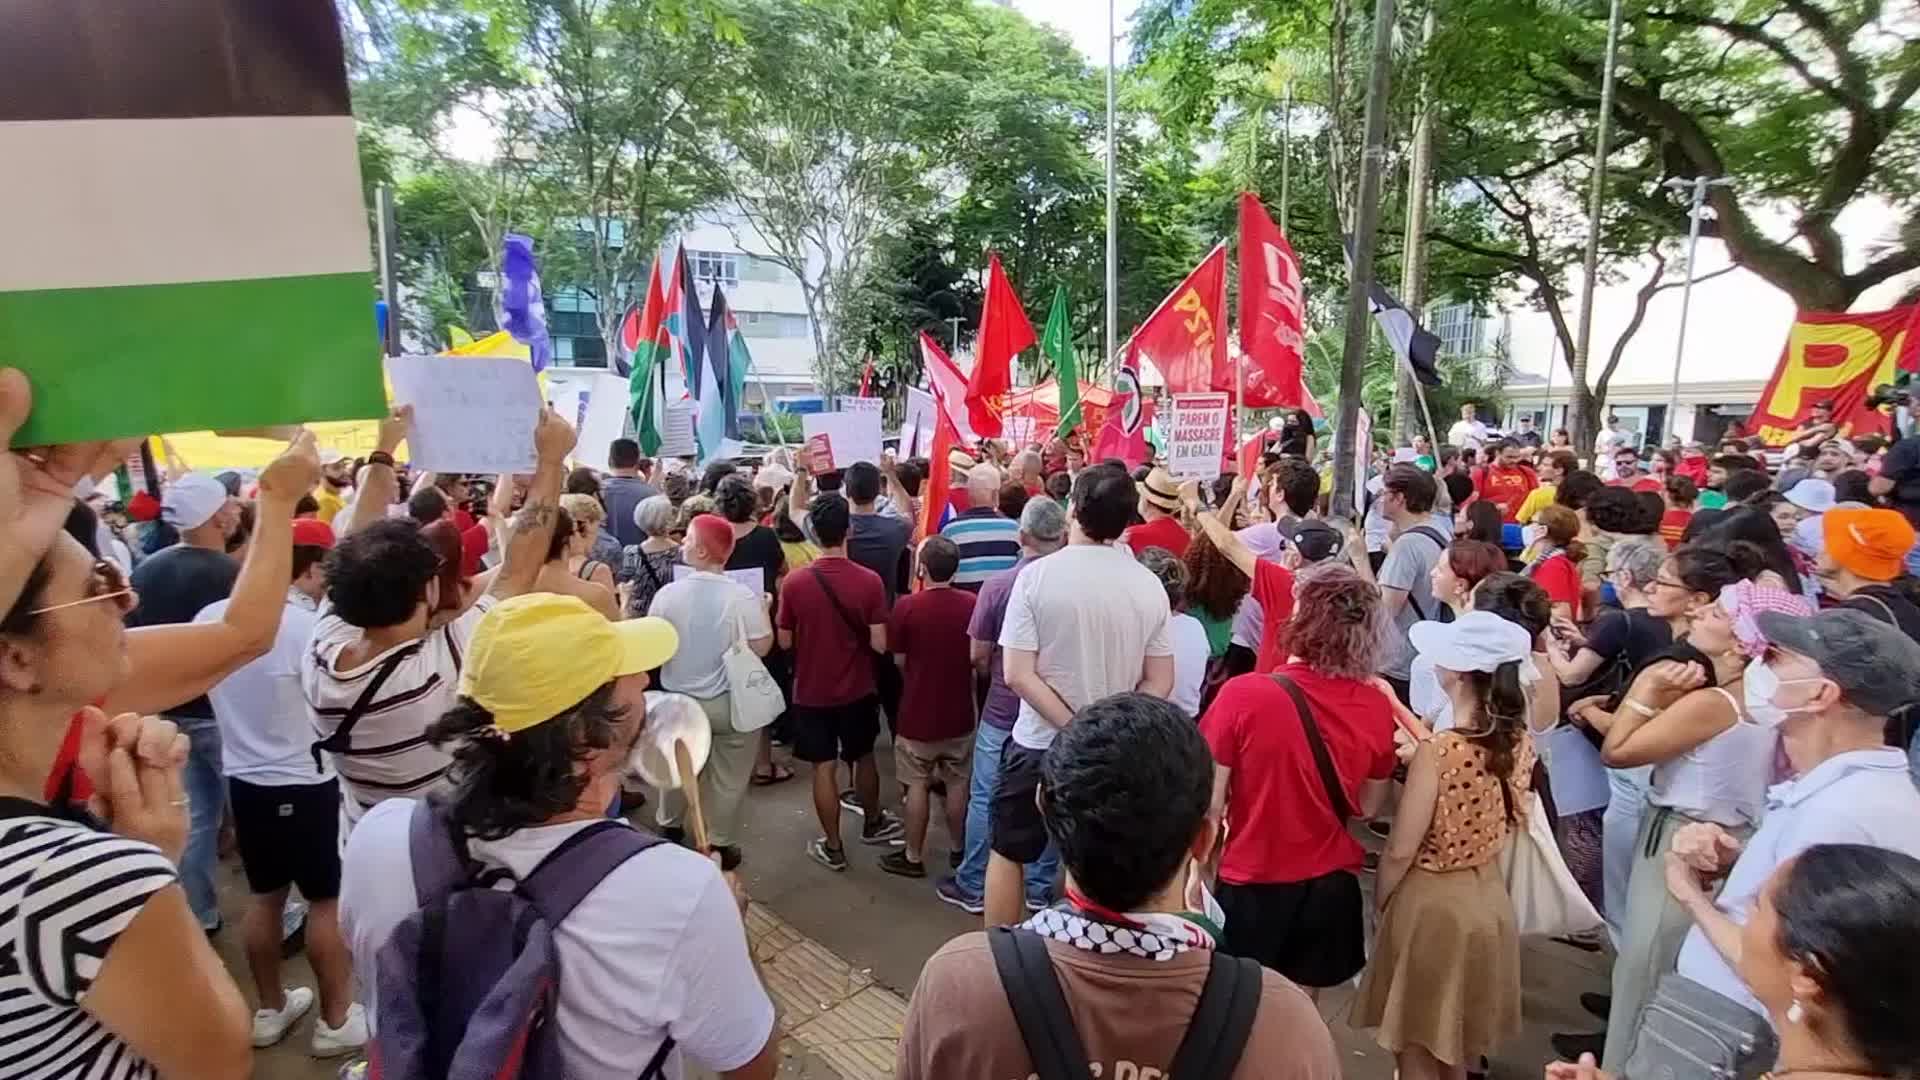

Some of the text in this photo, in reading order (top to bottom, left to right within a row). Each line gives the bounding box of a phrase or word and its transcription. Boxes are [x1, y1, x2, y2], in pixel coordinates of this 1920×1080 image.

[1179, 411, 1219, 426] PAREM O
[1174, 427, 1220, 442] MASSACRE
[1176, 445, 1189, 458] EM
